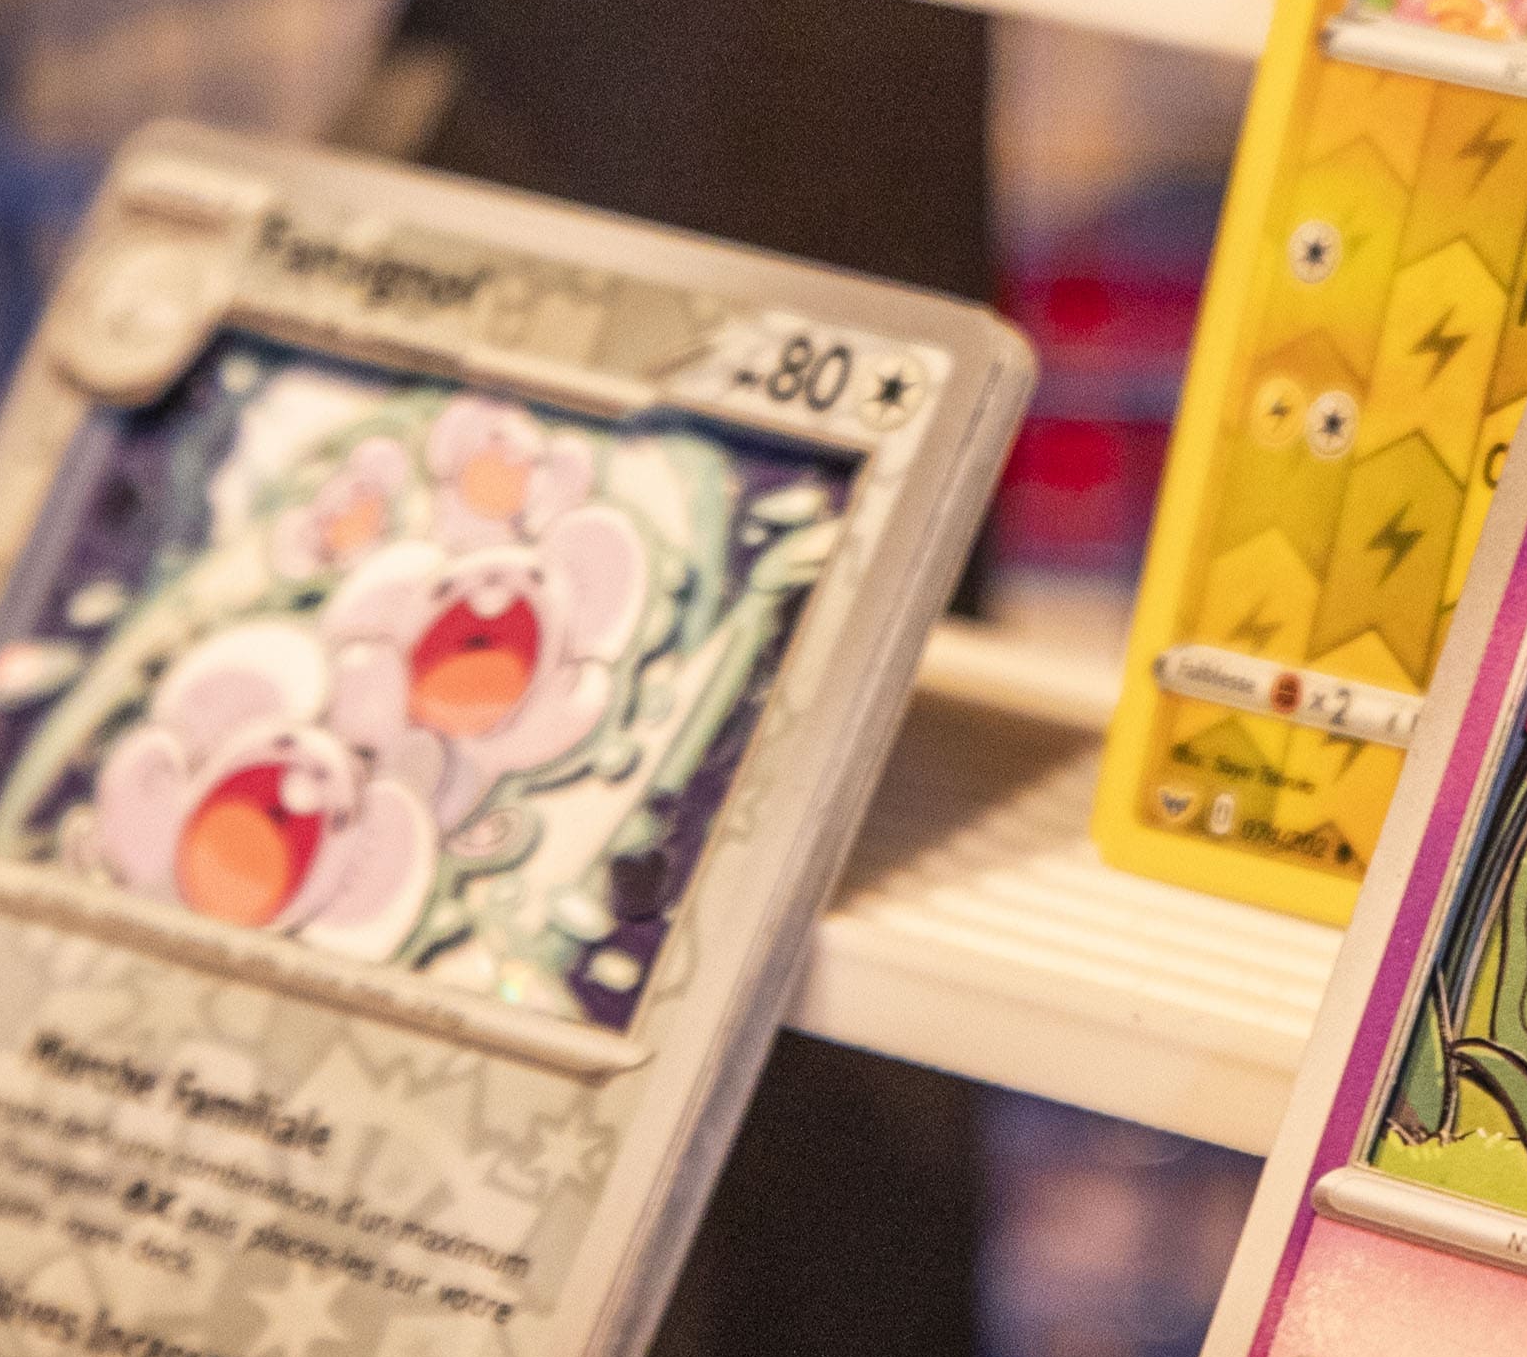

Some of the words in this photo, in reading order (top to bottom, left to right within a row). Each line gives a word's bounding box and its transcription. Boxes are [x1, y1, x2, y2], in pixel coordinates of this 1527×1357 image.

[767, 332, 852, 414] 80
[400, 1219, 532, 1280] maximum
[383, 1266, 431, 1297] sur
[437, 1283, 514, 1327] votre
